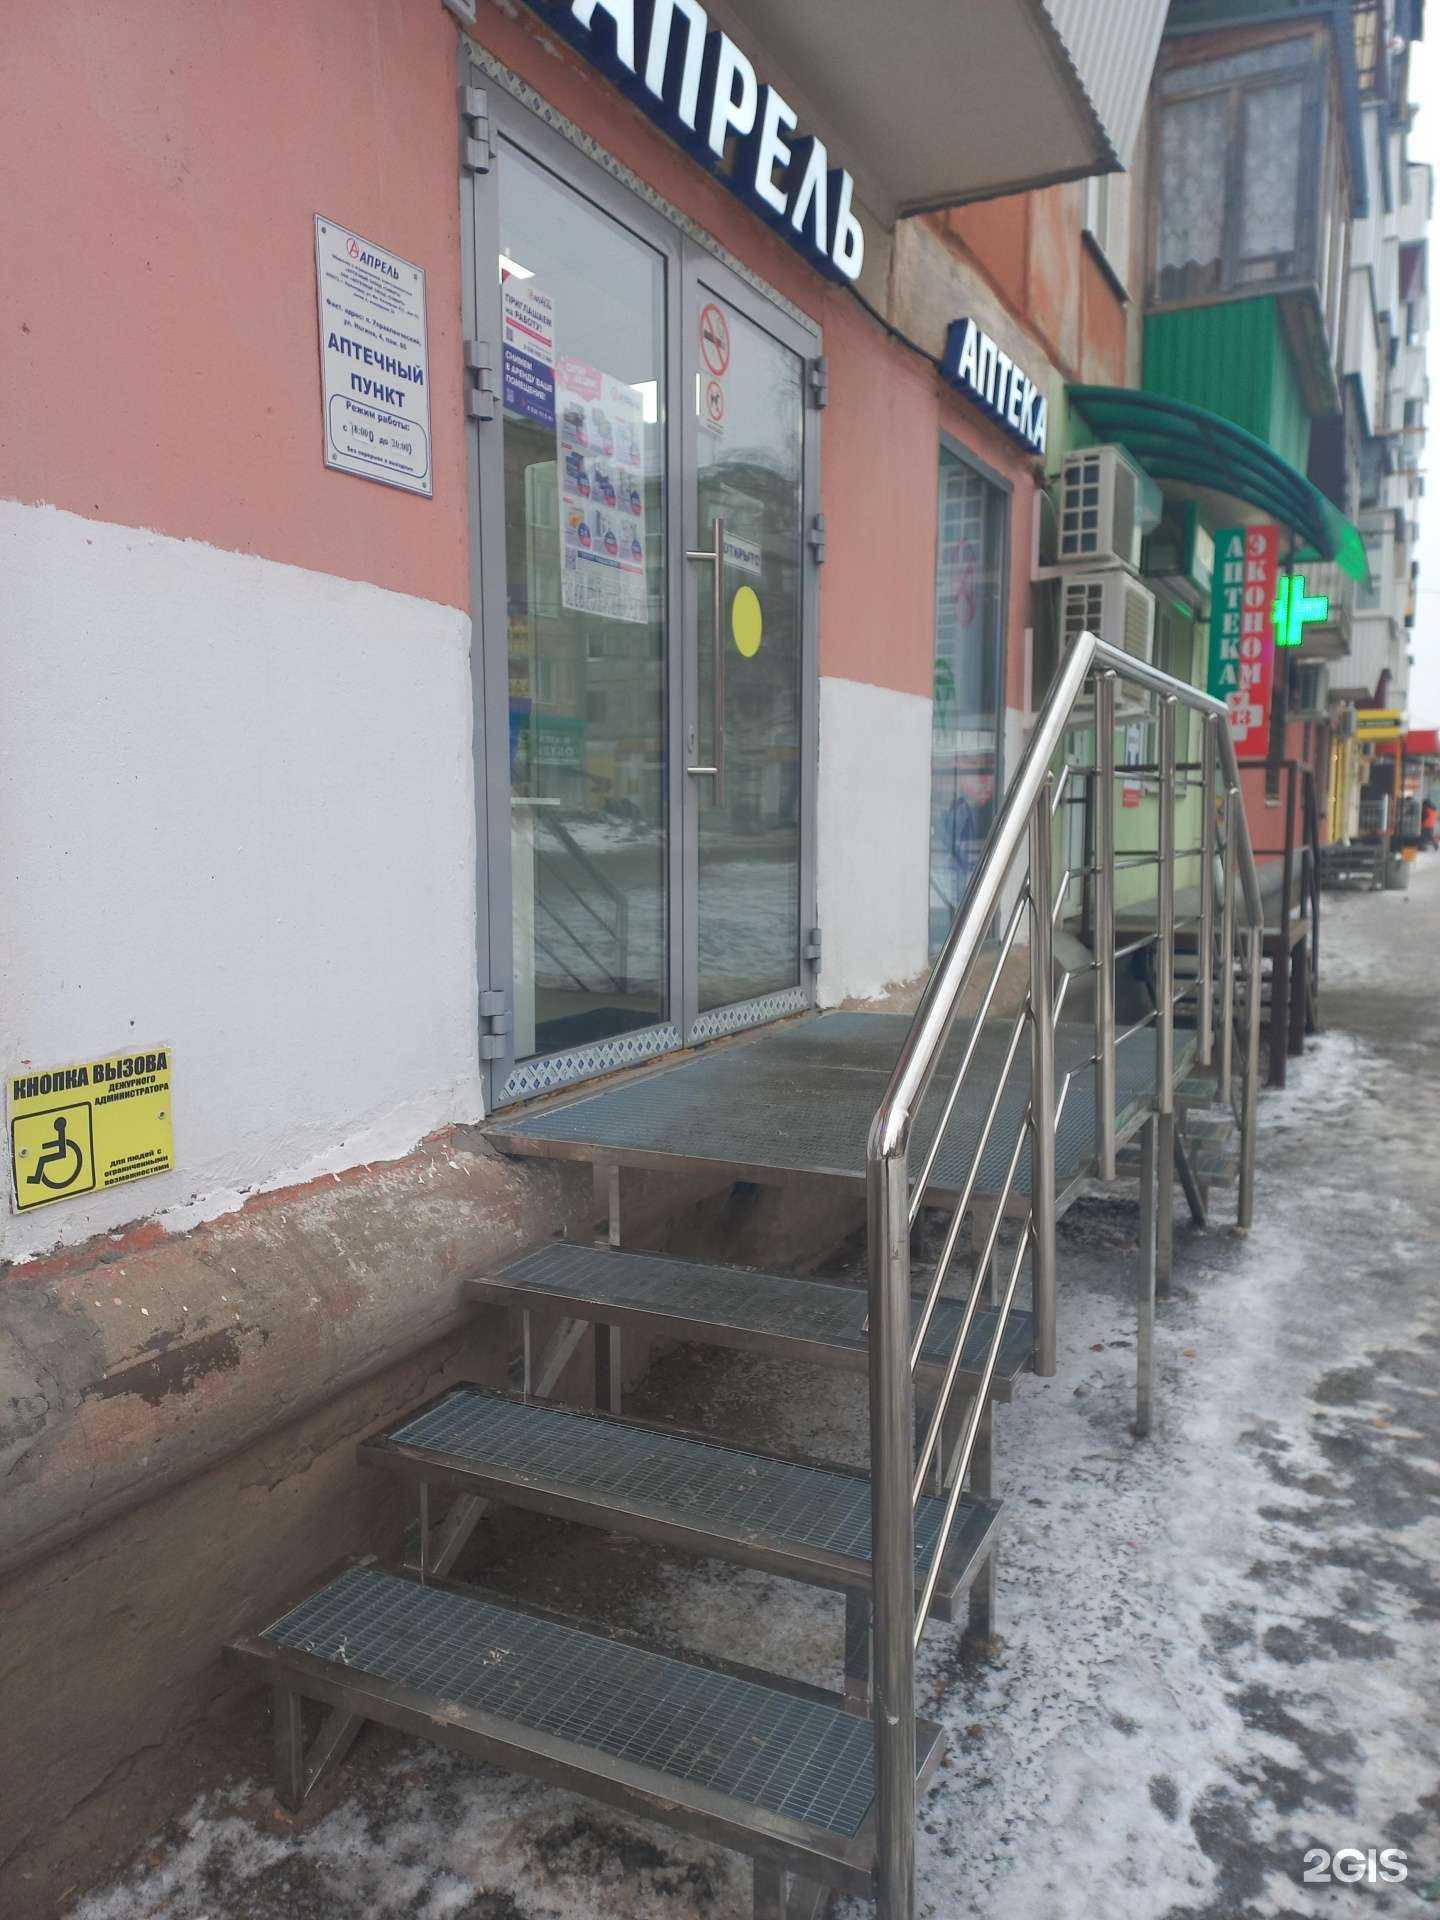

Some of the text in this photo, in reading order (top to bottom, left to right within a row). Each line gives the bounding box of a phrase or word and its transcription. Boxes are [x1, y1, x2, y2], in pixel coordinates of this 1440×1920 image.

[360, 251, 399, 280] АПРЕЛЬ
[328, 332, 424, 386] АПТЕЧНЫЙ
[351, 372, 406, 408] ПУНКТ
[958, 317, 1048, 454] АПТЕКА
[346, 400, 410, 432] Режим работы:
[1218, 535, 1244, 685] АПТЕКА
[1240, 534, 1267, 685] ЭКОНОМ
[14, 1052, 168, 1100] КНОПКА ВЫЗОВА
[108, 1075, 156, 1092] ДЕЖУРНОГО
[94, 1082, 169, 1106] АДМИНИСТРАТОРА
[104, 1155, 168, 1177] ограниченными
[104, 1163, 170, 1186] возможностями
[110, 1158, 126, 1168] для
[127, 1150, 154, 1163] людей
